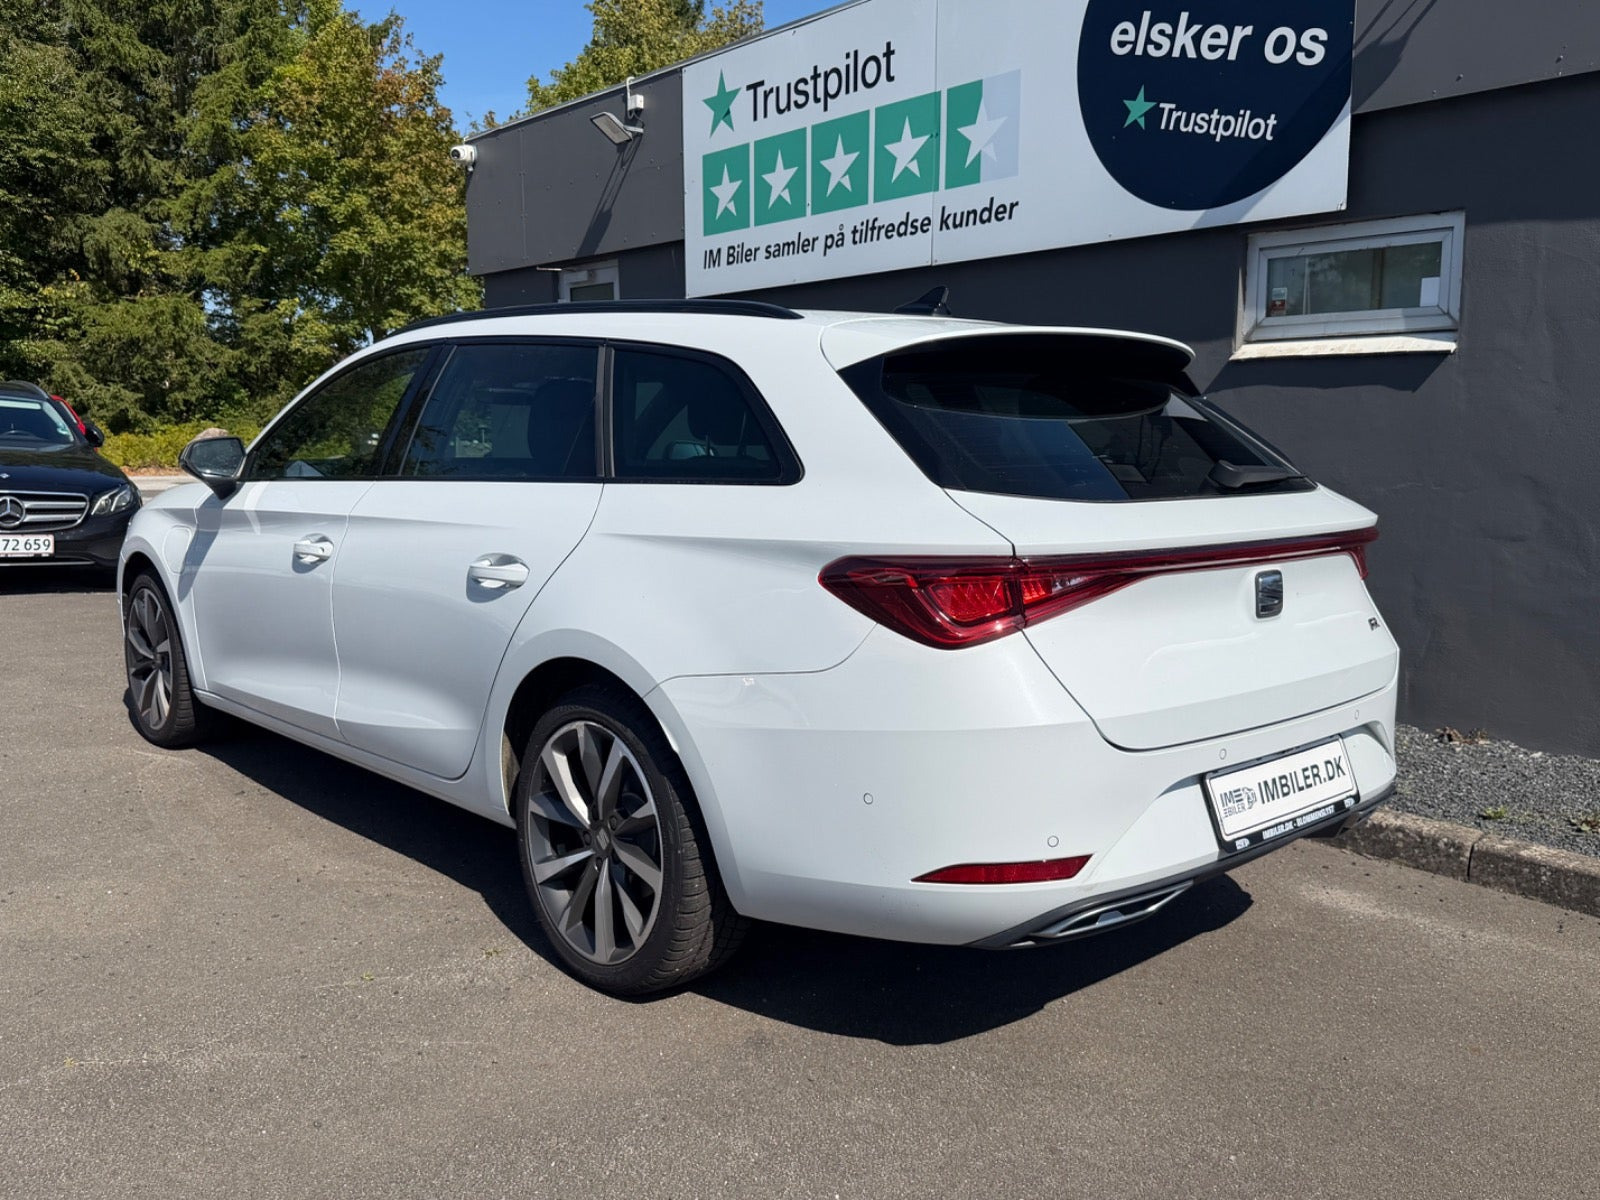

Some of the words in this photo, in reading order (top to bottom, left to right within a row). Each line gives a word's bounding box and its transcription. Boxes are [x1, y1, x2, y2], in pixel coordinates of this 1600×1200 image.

[1110, 10, 1253, 61] elsker
[1264, 26, 1328, 66] os
[746, 41, 895, 122] Trustpilot
[1159, 102, 1277, 142] Trustpilot
[703, 249, 721, 270] IM
[726, 242, 761, 267] Biler
[764, 232, 819, 259] samler
[823, 224, 845, 256] på
[851, 211, 932, 245] tilfredse
[938, 197, 1019, 232] kunder
[2, 538, 20, 551] 72
[24, 538, 51, 551] 659
[1258, 755, 1346, 804] IMBILER.DK
